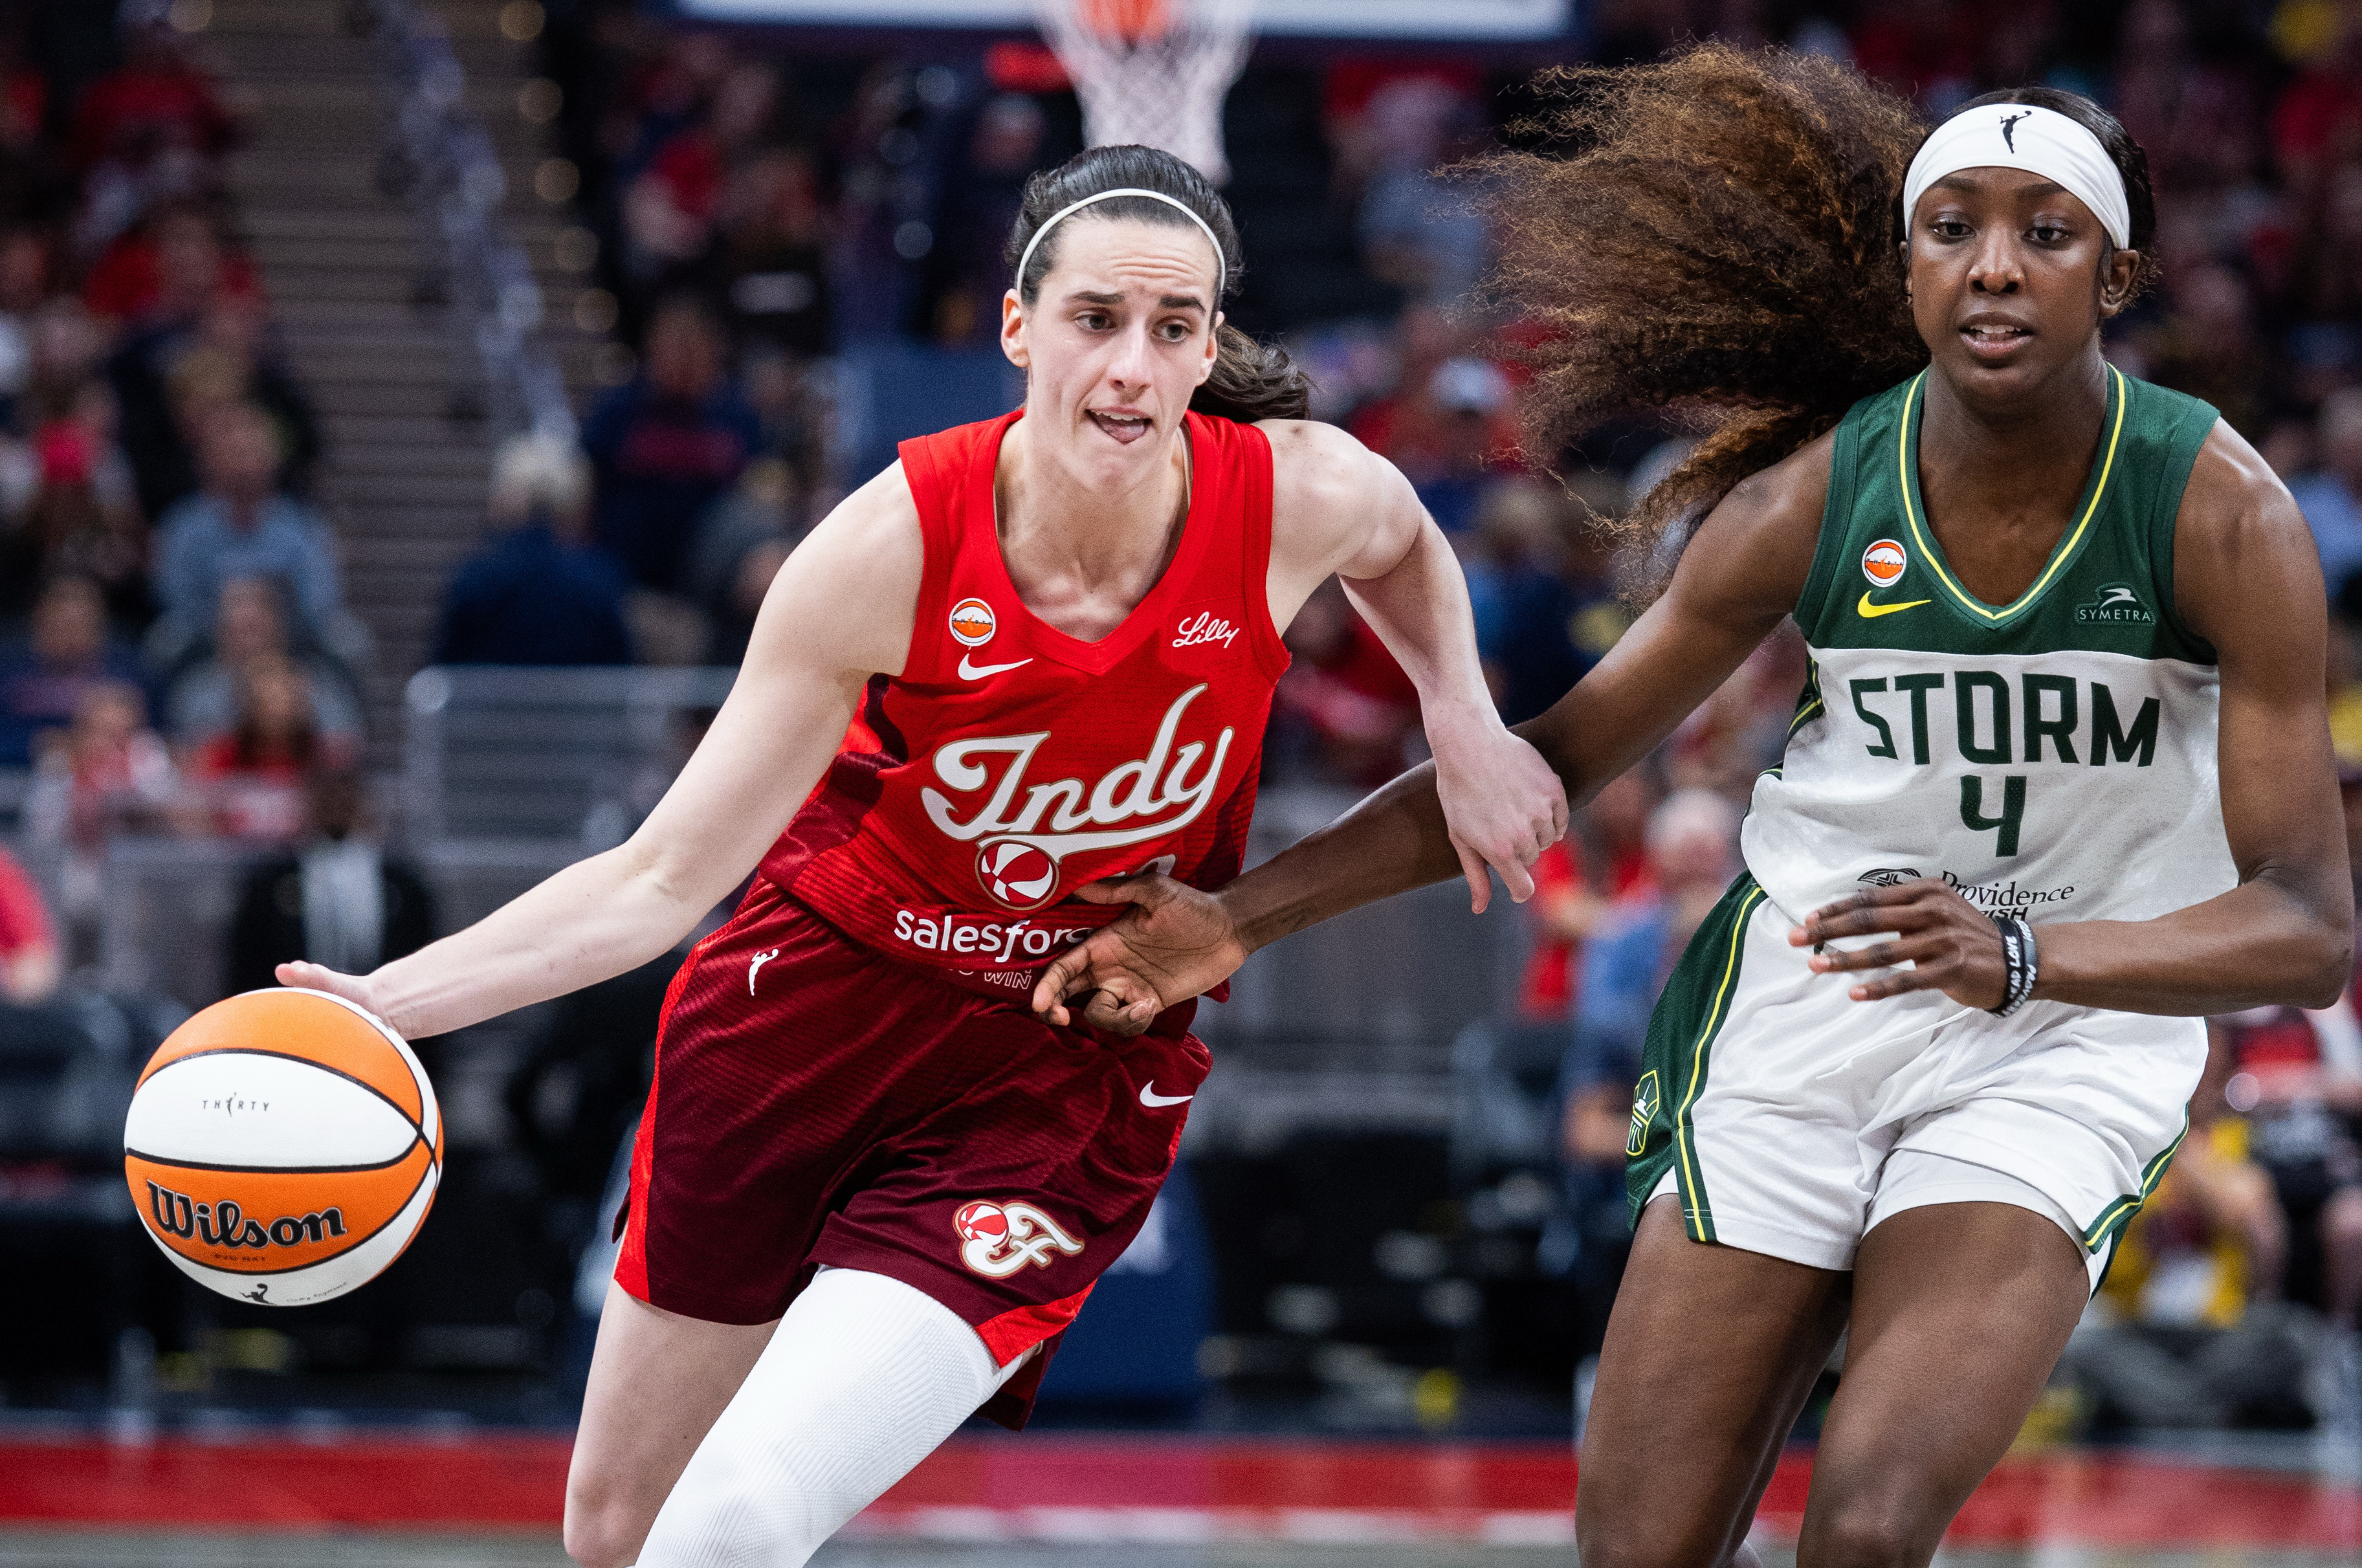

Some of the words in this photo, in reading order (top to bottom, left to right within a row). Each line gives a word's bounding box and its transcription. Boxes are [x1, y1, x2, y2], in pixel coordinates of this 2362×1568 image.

[1172, 611, 1240, 648] Lilly
[2079, 609, 2150, 621] SYMETRA
[1849, 670, 2160, 767] STORM
[921, 682, 1235, 865] Indy
[1960, 775, 2027, 858] 4
[1941, 870, 2075, 906] Providence
[894, 910, 1092, 963] salesforc
[984, 971, 1032, 989] WIN
[146, 1178, 348, 1249] Wilson
